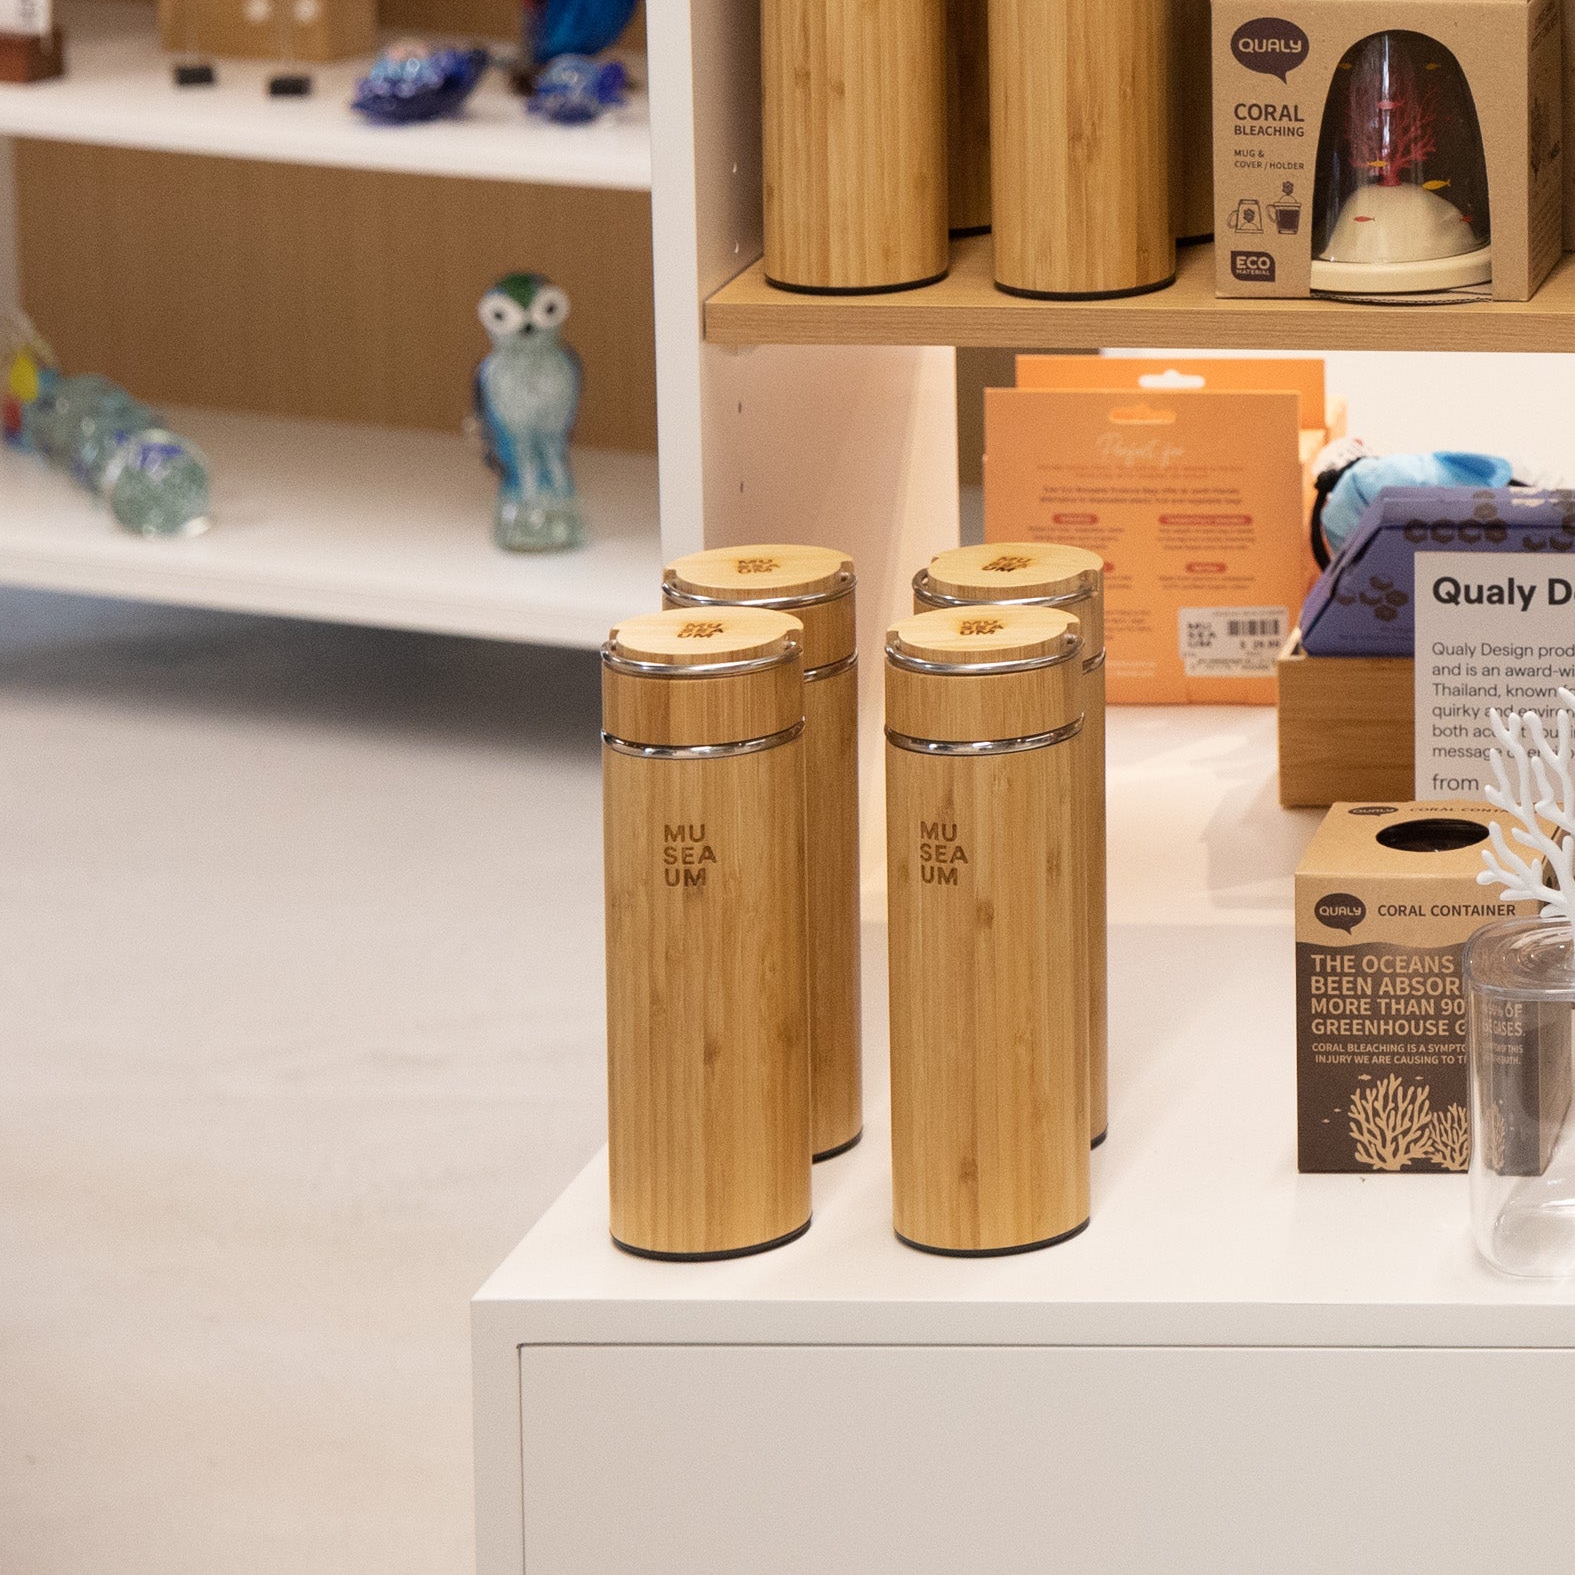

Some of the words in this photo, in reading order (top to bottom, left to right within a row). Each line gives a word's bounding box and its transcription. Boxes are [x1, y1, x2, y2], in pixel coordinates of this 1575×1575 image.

[1238, 38, 1302, 53] QUALY
[1234, 103, 1305, 122] CORAL
[1234, 125, 1305, 137] BLEACHING
[1234, 149, 1256, 158] MUG
[1234, 160, 1262, 169] COVER
[1270, 161, 1305, 170] HOLDER
[1235, 256, 1271, 270] ECO
[1431, 576, 1538, 612] Qualy
[1432, 641, 1476, 659] Qualy
[1481, 642, 1534, 660] Design
[1432, 663, 1461, 677] and
[1466, 663, 1477, 677] is
[1481, 665, 1501, 677] an
[1432, 683, 1502, 699] Thailand,
[1506, 684, 1558, 698] known
[1432, 704, 1480, 720] quirky
[1432, 725, 1469, 739] both
[1431, 774, 1479, 793] from
[664, 824, 706, 843] MU
[920, 821, 958, 841] MU
[663, 846, 717, 866] SEA
[920, 843, 968, 865] SEA
[665, 868, 707, 887] UM
[921, 865, 958, 886] UM
[1319, 906, 1362, 916] QUALY
[1378, 904, 1426, 917] CORAL
[1430, 904, 1516, 917] CONTAINER
[1311, 954, 1356, 973] THE
[1361, 954, 1455, 974] OCEANS
[1311, 977, 1372, 996] BEEN
[1311, 998, 1372, 1015] MORE
[1377, 998, 1435, 1015] THAN
[1311, 1019, 1450, 1036] GREENHOUSE
[1312, 1043, 1345, 1052] CORAL
[1347, 1043, 1405, 1053] BLEACHING
[1407, 1043, 1417, 1053] IS
